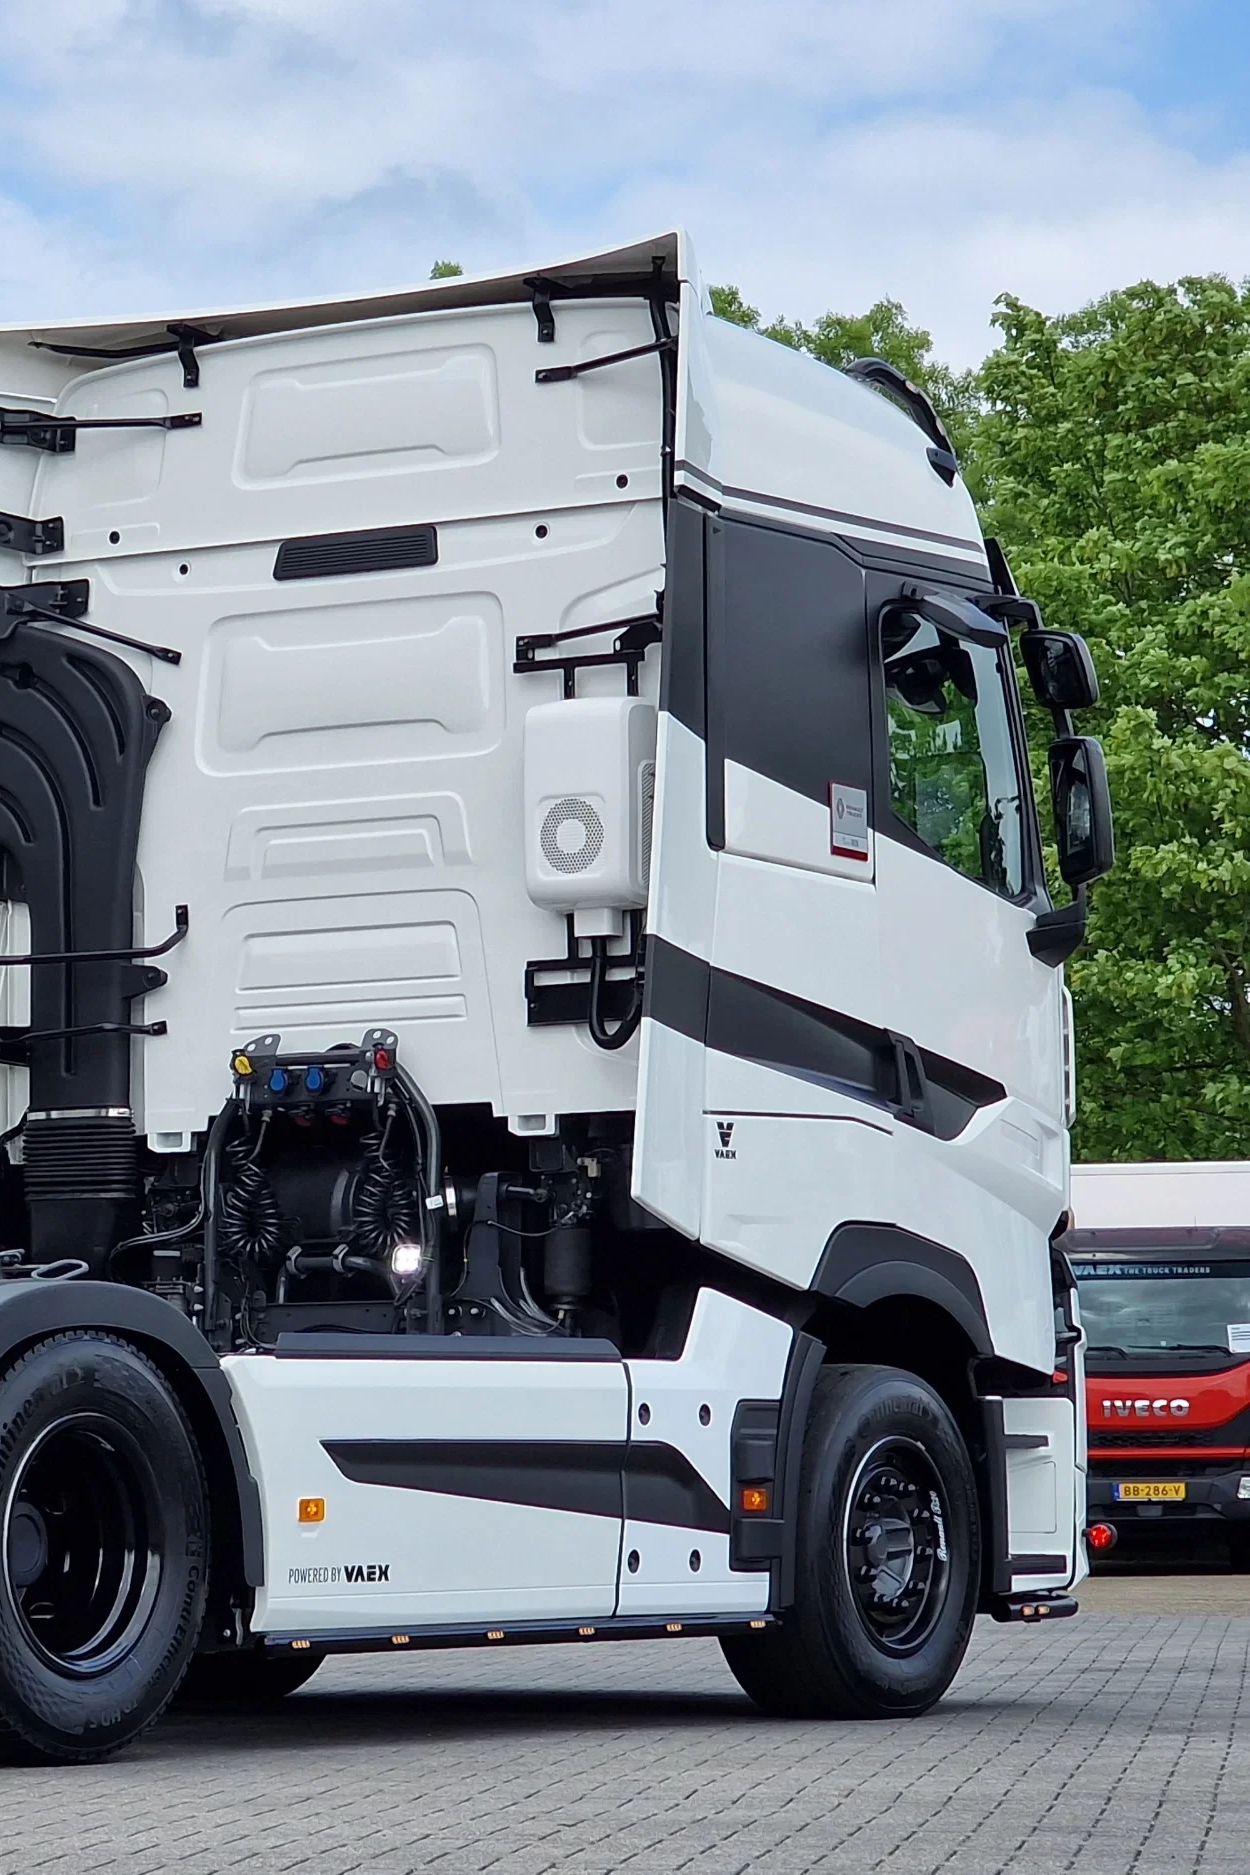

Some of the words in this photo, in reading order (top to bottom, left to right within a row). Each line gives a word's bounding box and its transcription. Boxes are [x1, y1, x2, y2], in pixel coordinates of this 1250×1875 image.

[714, 1149, 737, 1160] VAEX
[1074, 1264, 1123, 1276] VAEX
[1124, 1266, 1140, 1275] THE
[1142, 1266, 1170, 1275] TRUCK
[1173, 1265, 1211, 1275] TRADERS
[1102, 1398, 1190, 1418] IVECO
[1123, 1485, 1182, 1497] BB-286-V
[288, 1566, 329, 1584] POWERED
[331, 1566, 342, 1583] BY
[343, 1564, 391, 1583] VAEX
